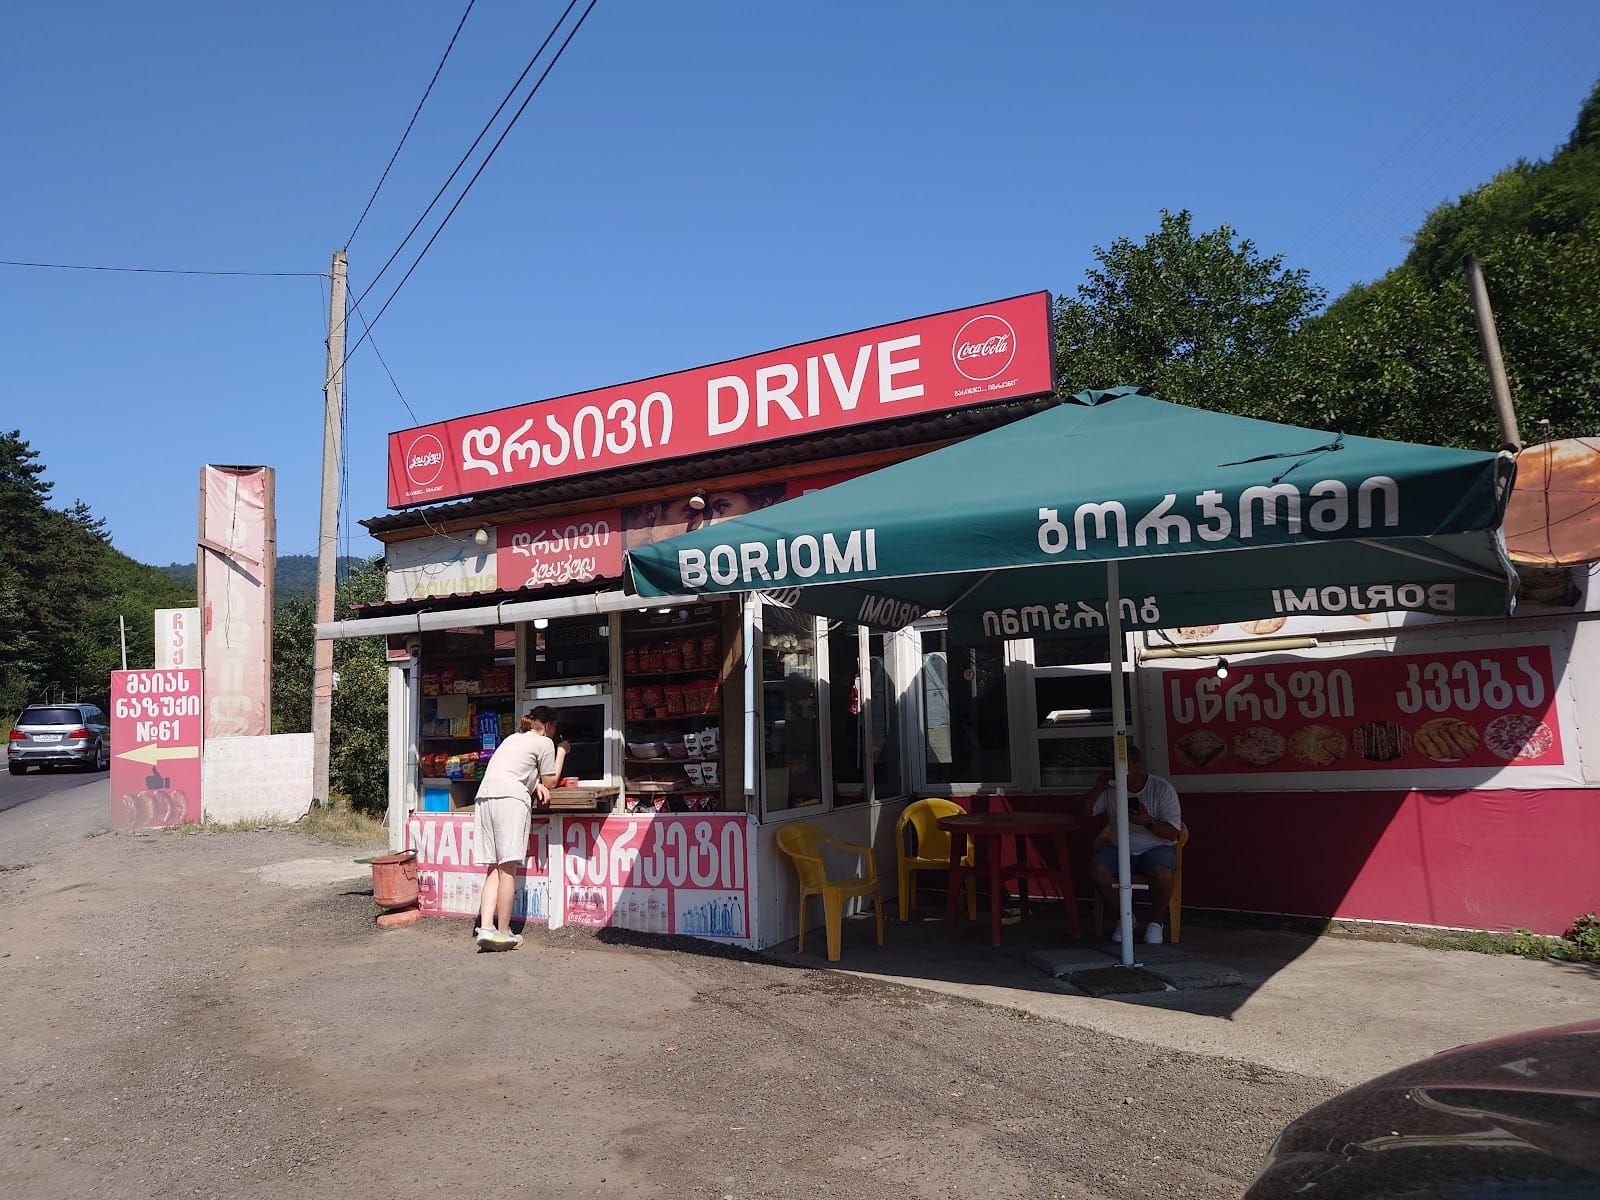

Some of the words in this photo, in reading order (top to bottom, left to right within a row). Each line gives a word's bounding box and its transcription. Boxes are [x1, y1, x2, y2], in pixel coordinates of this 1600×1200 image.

[957, 333, 1010, 361] Coca-Cola
[462, 392, 673, 476] დრაივი
[708, 334, 924, 436] DRIVE
[511, 520, 611, 558] დრაივი
[1038, 475, 1399, 554] ბორჯომი
[679, 528, 877, 589] BORJOMI
[172, 613, 184, 668] ჩაქ
[116, 696, 200, 719] ნაზუქი
[127, 672, 190, 695] მაიას
[1170, 667, 1354, 724] სწრაფი
[1396, 656, 1546, 714] კვება
[136, 720, 181, 742] №61
[409, 820, 549, 871] MART
[565, 820, 744, 889] მარკეტი
